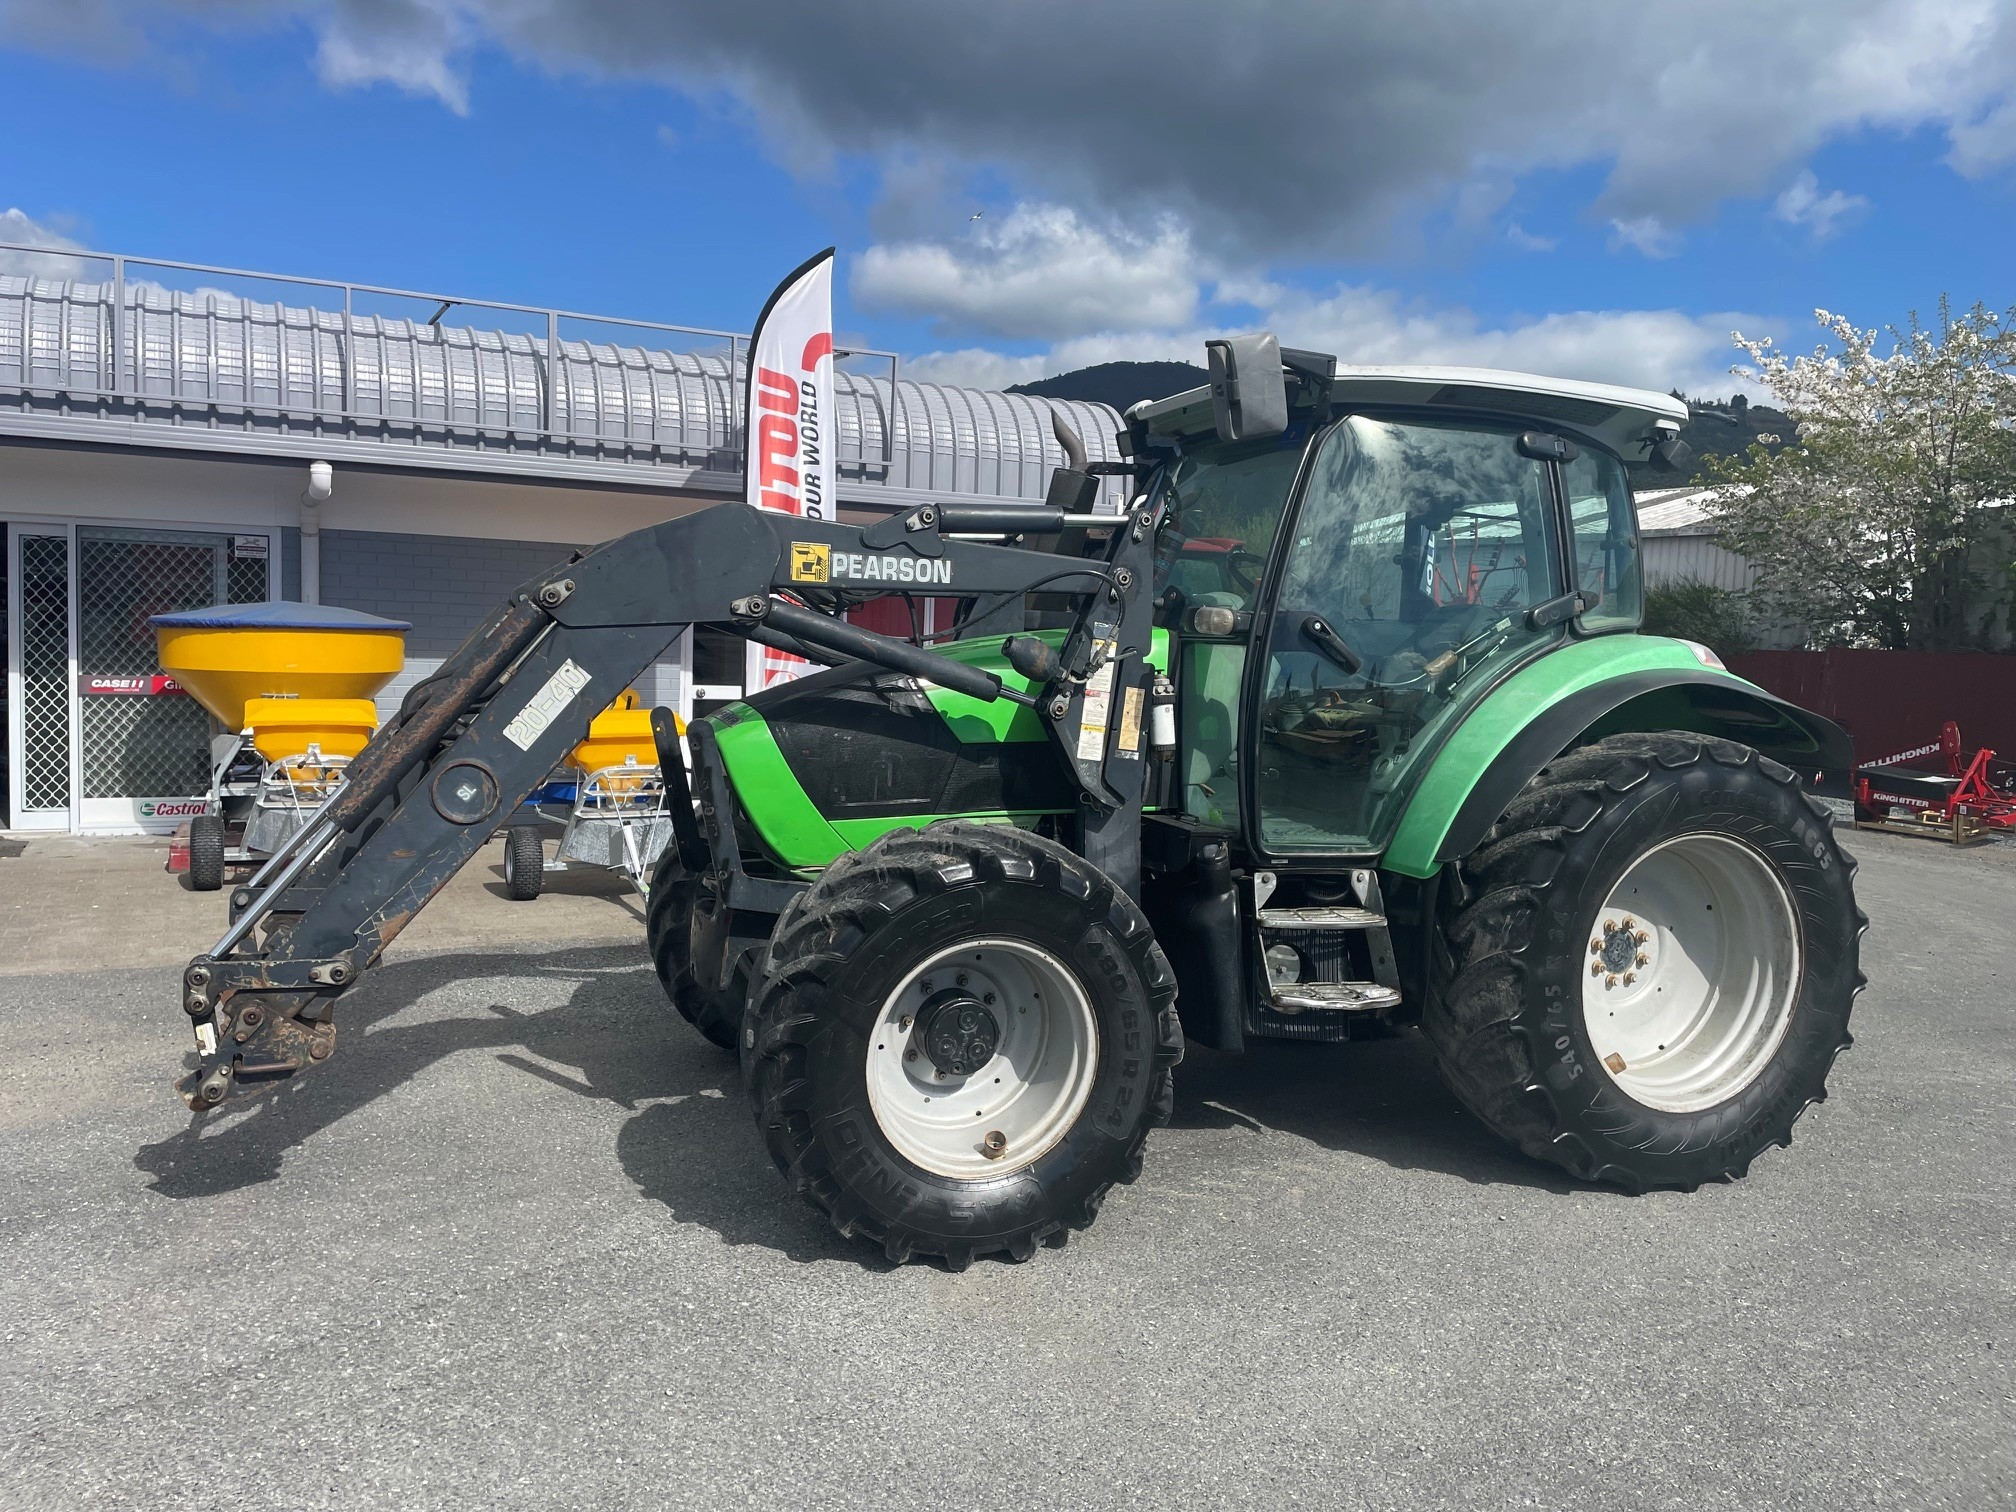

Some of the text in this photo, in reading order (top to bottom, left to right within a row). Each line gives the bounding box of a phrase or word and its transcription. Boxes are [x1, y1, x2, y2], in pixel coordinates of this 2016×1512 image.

[800, 380, 820, 466] WORLD
[832, 553, 951, 584] PEARSON
[91, 678, 130, 688] CASE
[508, 663, 588, 747] 20-40
[457, 785, 477, 800] SL
[156, 801, 207, 816] Castrol
